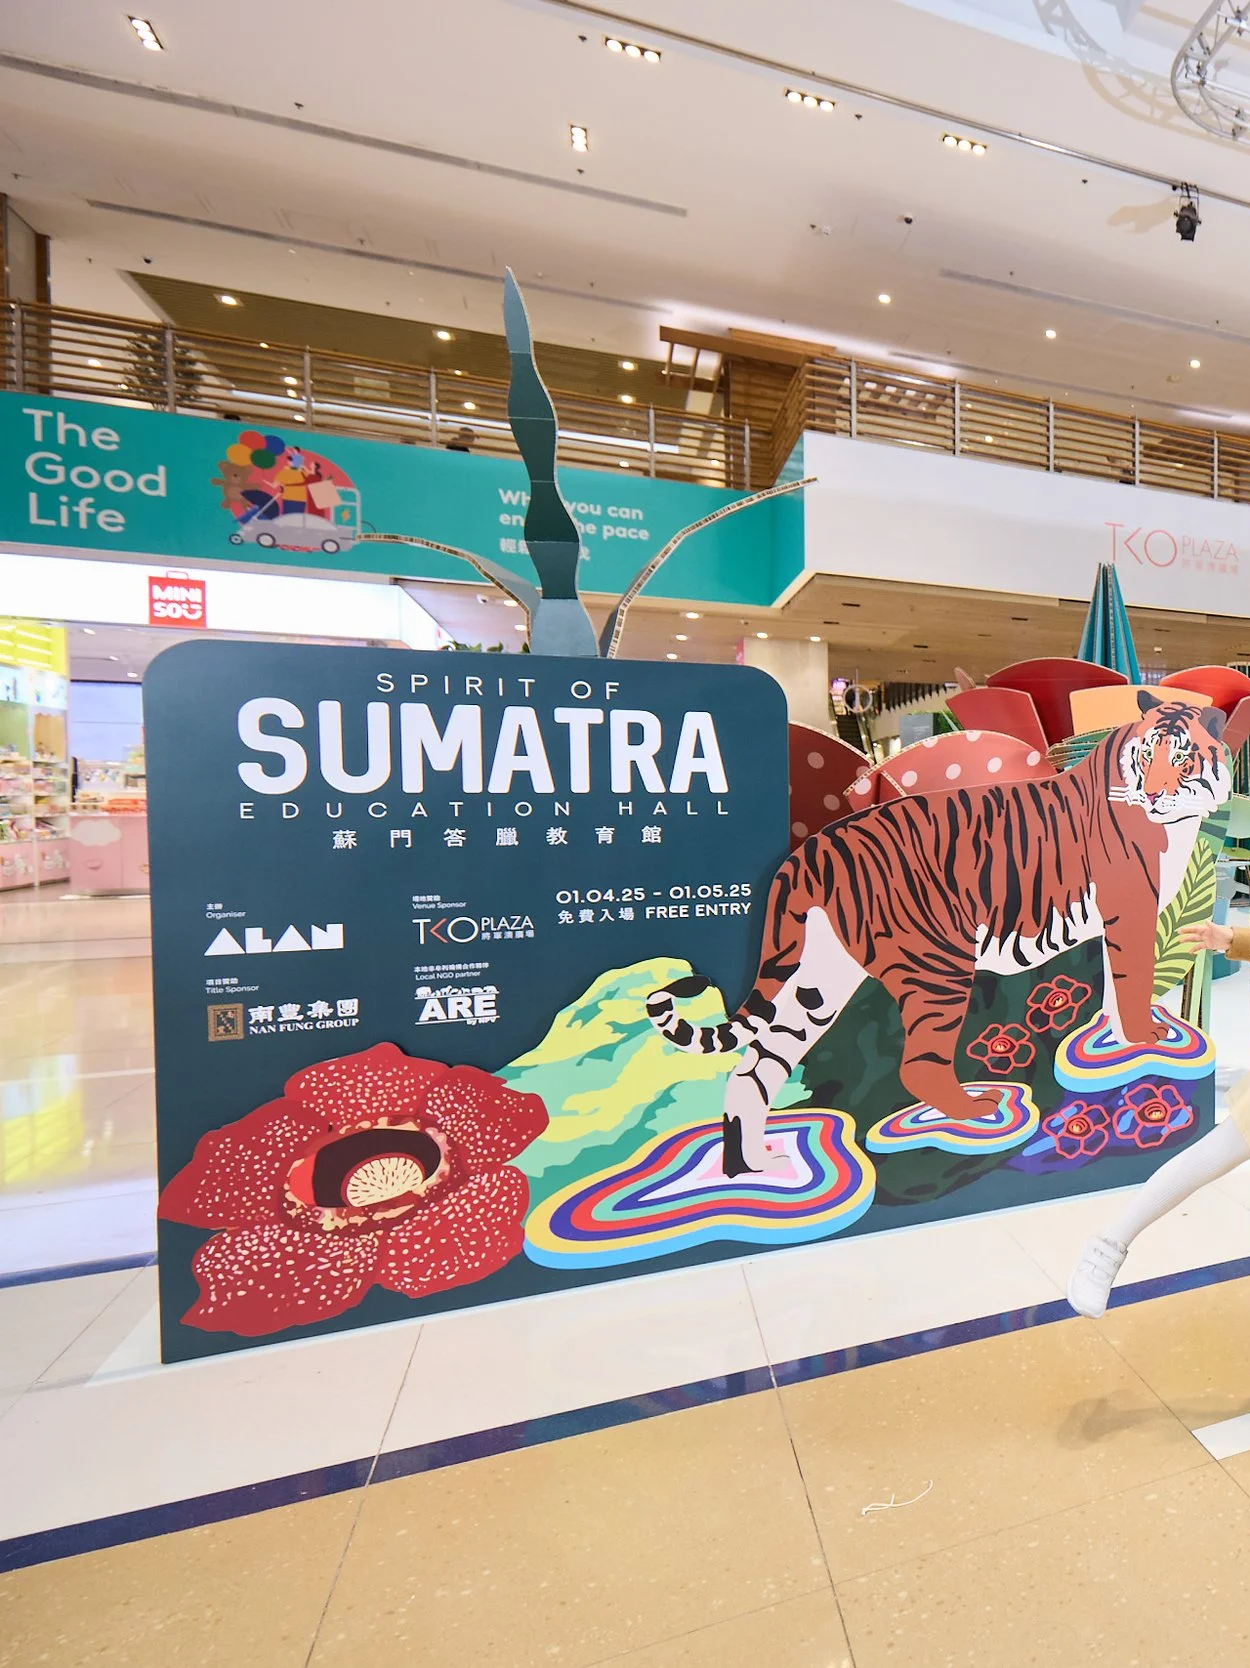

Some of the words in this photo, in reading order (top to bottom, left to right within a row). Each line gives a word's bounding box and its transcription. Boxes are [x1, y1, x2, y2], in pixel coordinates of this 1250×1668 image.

[22, 407, 121, 451] The
[25, 451, 168, 498] Good
[28, 492, 126, 533] Life
[563, 500, 602, 516] you
[607, 505, 644, 521] can
[603, 524, 650, 541] pace
[1181, 534, 1240, 562] PLAZA
[152, 584, 202, 602] MINI
[376, 673, 537, 698] SPIRIT
[571, 680, 621, 700] OF
[237, 696, 730, 795] SUMATRA
[239, 800, 572, 820] EDUCATION
[618, 800, 730, 817] HALL
[332, 825, 663, 850] 蘇門答臘教育館
[555, 887, 646, 905] 01.04.25
[669, 883, 752, 900] 01.05.25
[205, 911, 247, 920] Organiser
[412, 902, 436, 910] Venue
[437, 901, 467, 910] Sponsor
[558, 906, 635, 924] 免費入場
[645, 904, 690, 919] FREE
[695, 902, 752, 917] ENTRY
[203, 923, 344, 956] ALAN
[412, 916, 480, 945] TKO
[481, 915, 535, 931] PLAZA
[415, 973, 436, 981] Local
[436, 972, 454, 980] NGO
[455, 971, 481, 979] partner
[225, 985, 260, 994] Sponsor
[419, 994, 497, 1021] ARE
[249, 1025, 277, 1035] NAN
[279, 1021, 314, 1032] FUNG
[316, 1018, 360, 1030] GROUP
